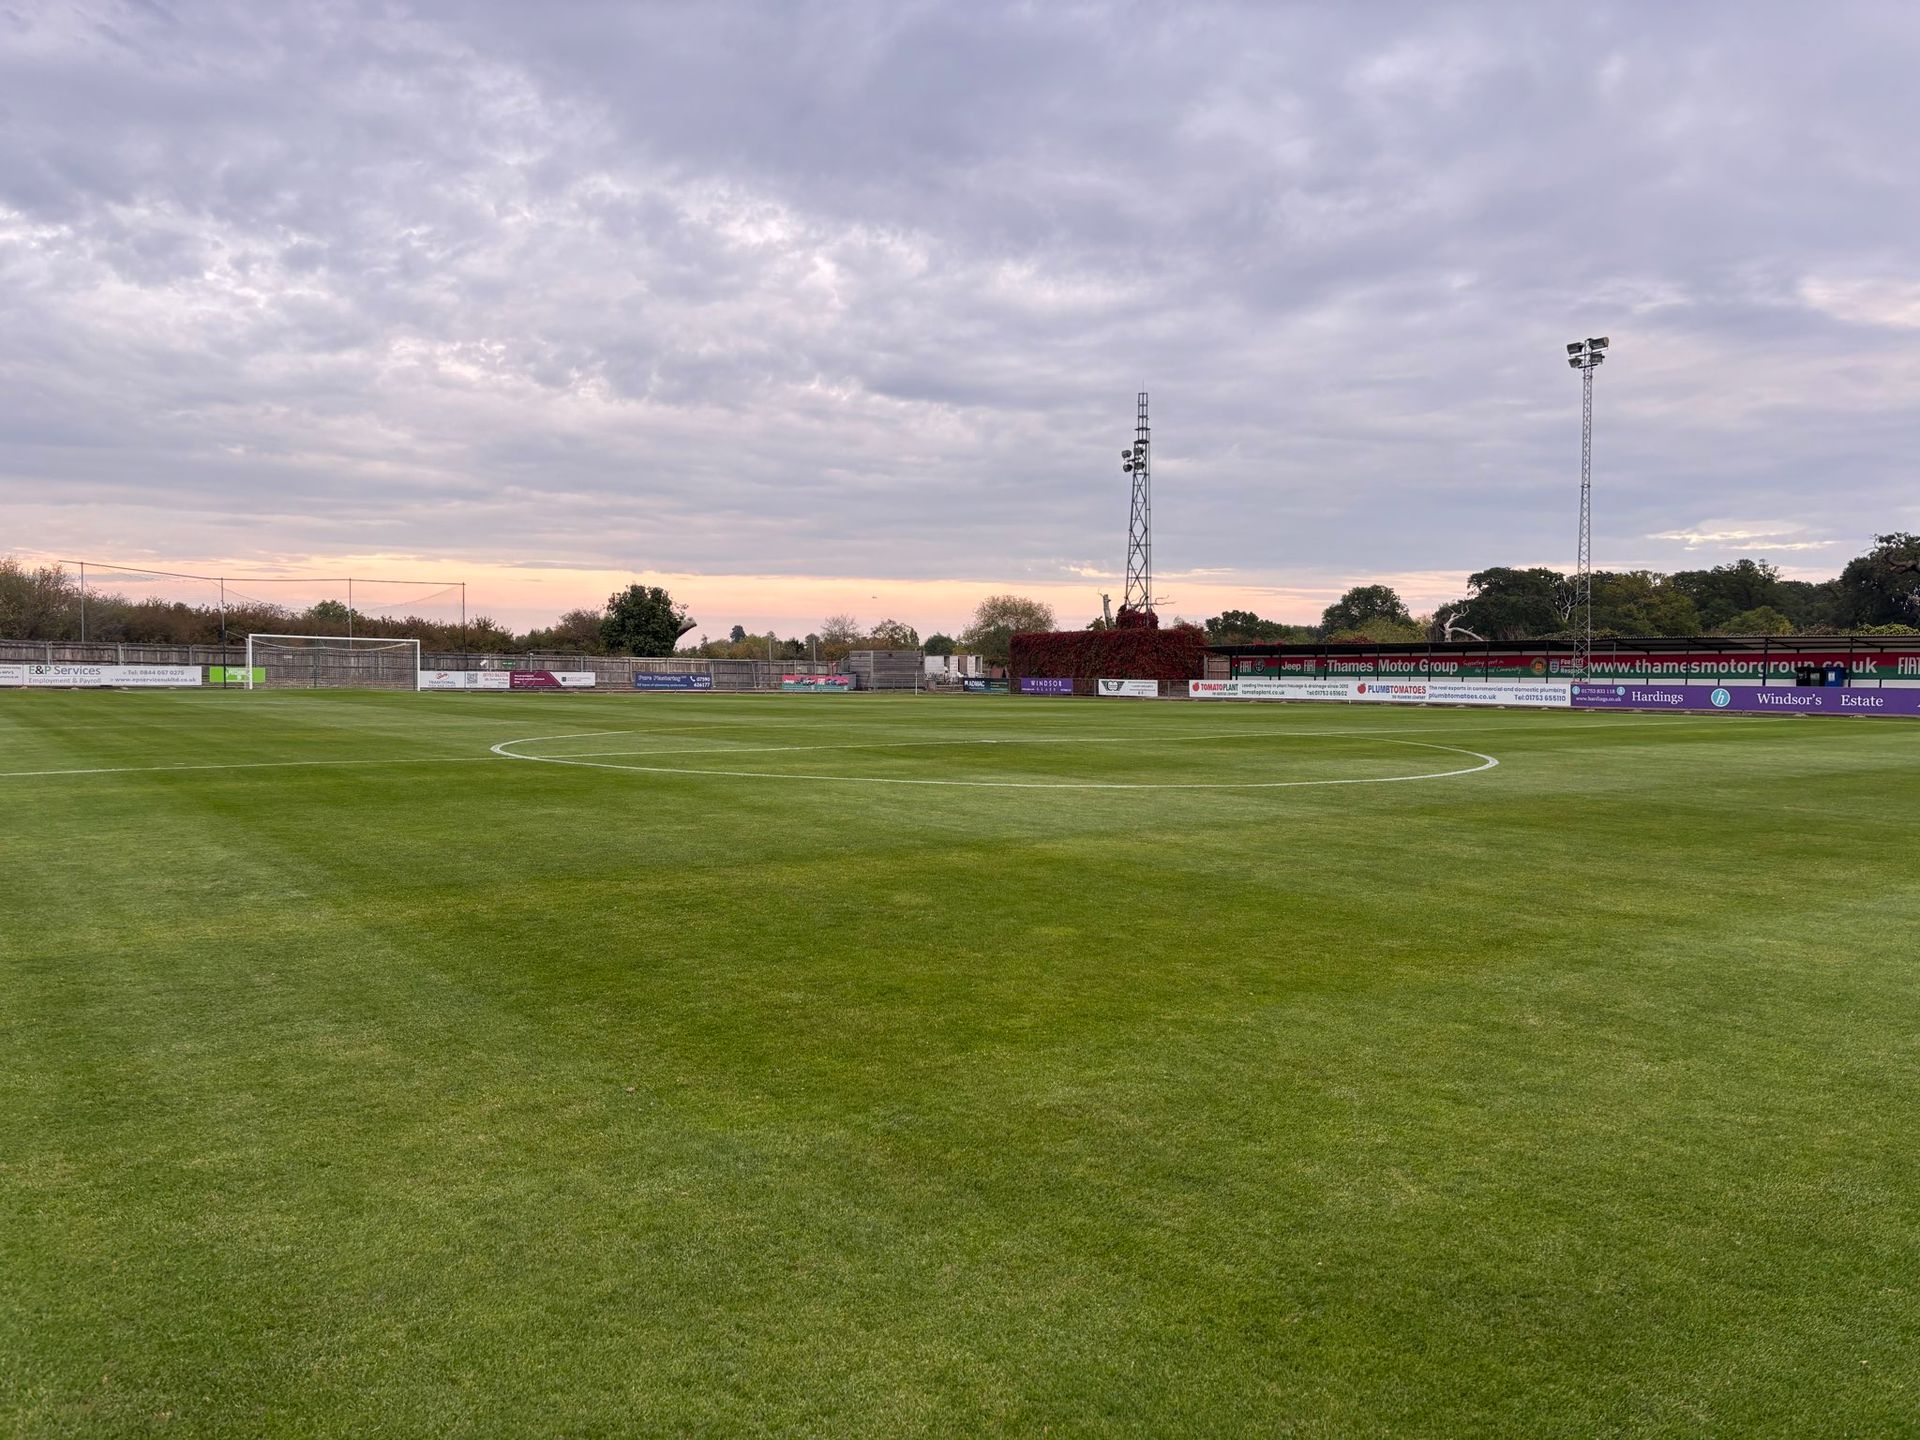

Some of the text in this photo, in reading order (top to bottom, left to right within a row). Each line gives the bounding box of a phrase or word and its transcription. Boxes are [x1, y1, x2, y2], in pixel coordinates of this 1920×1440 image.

[28, 665, 101, 675] E&P Services
[1282, 661, 1301, 672] Jeep
[1327, 658, 1458, 675] Thames Motor Group
[1201, 683, 1238, 691] TOMATOPLANT
[1367, 684, 1427, 694] PLUMBTOMATOES
[1632, 691, 1684, 705] Hardings
[1841, 695, 1884, 707] Estate
